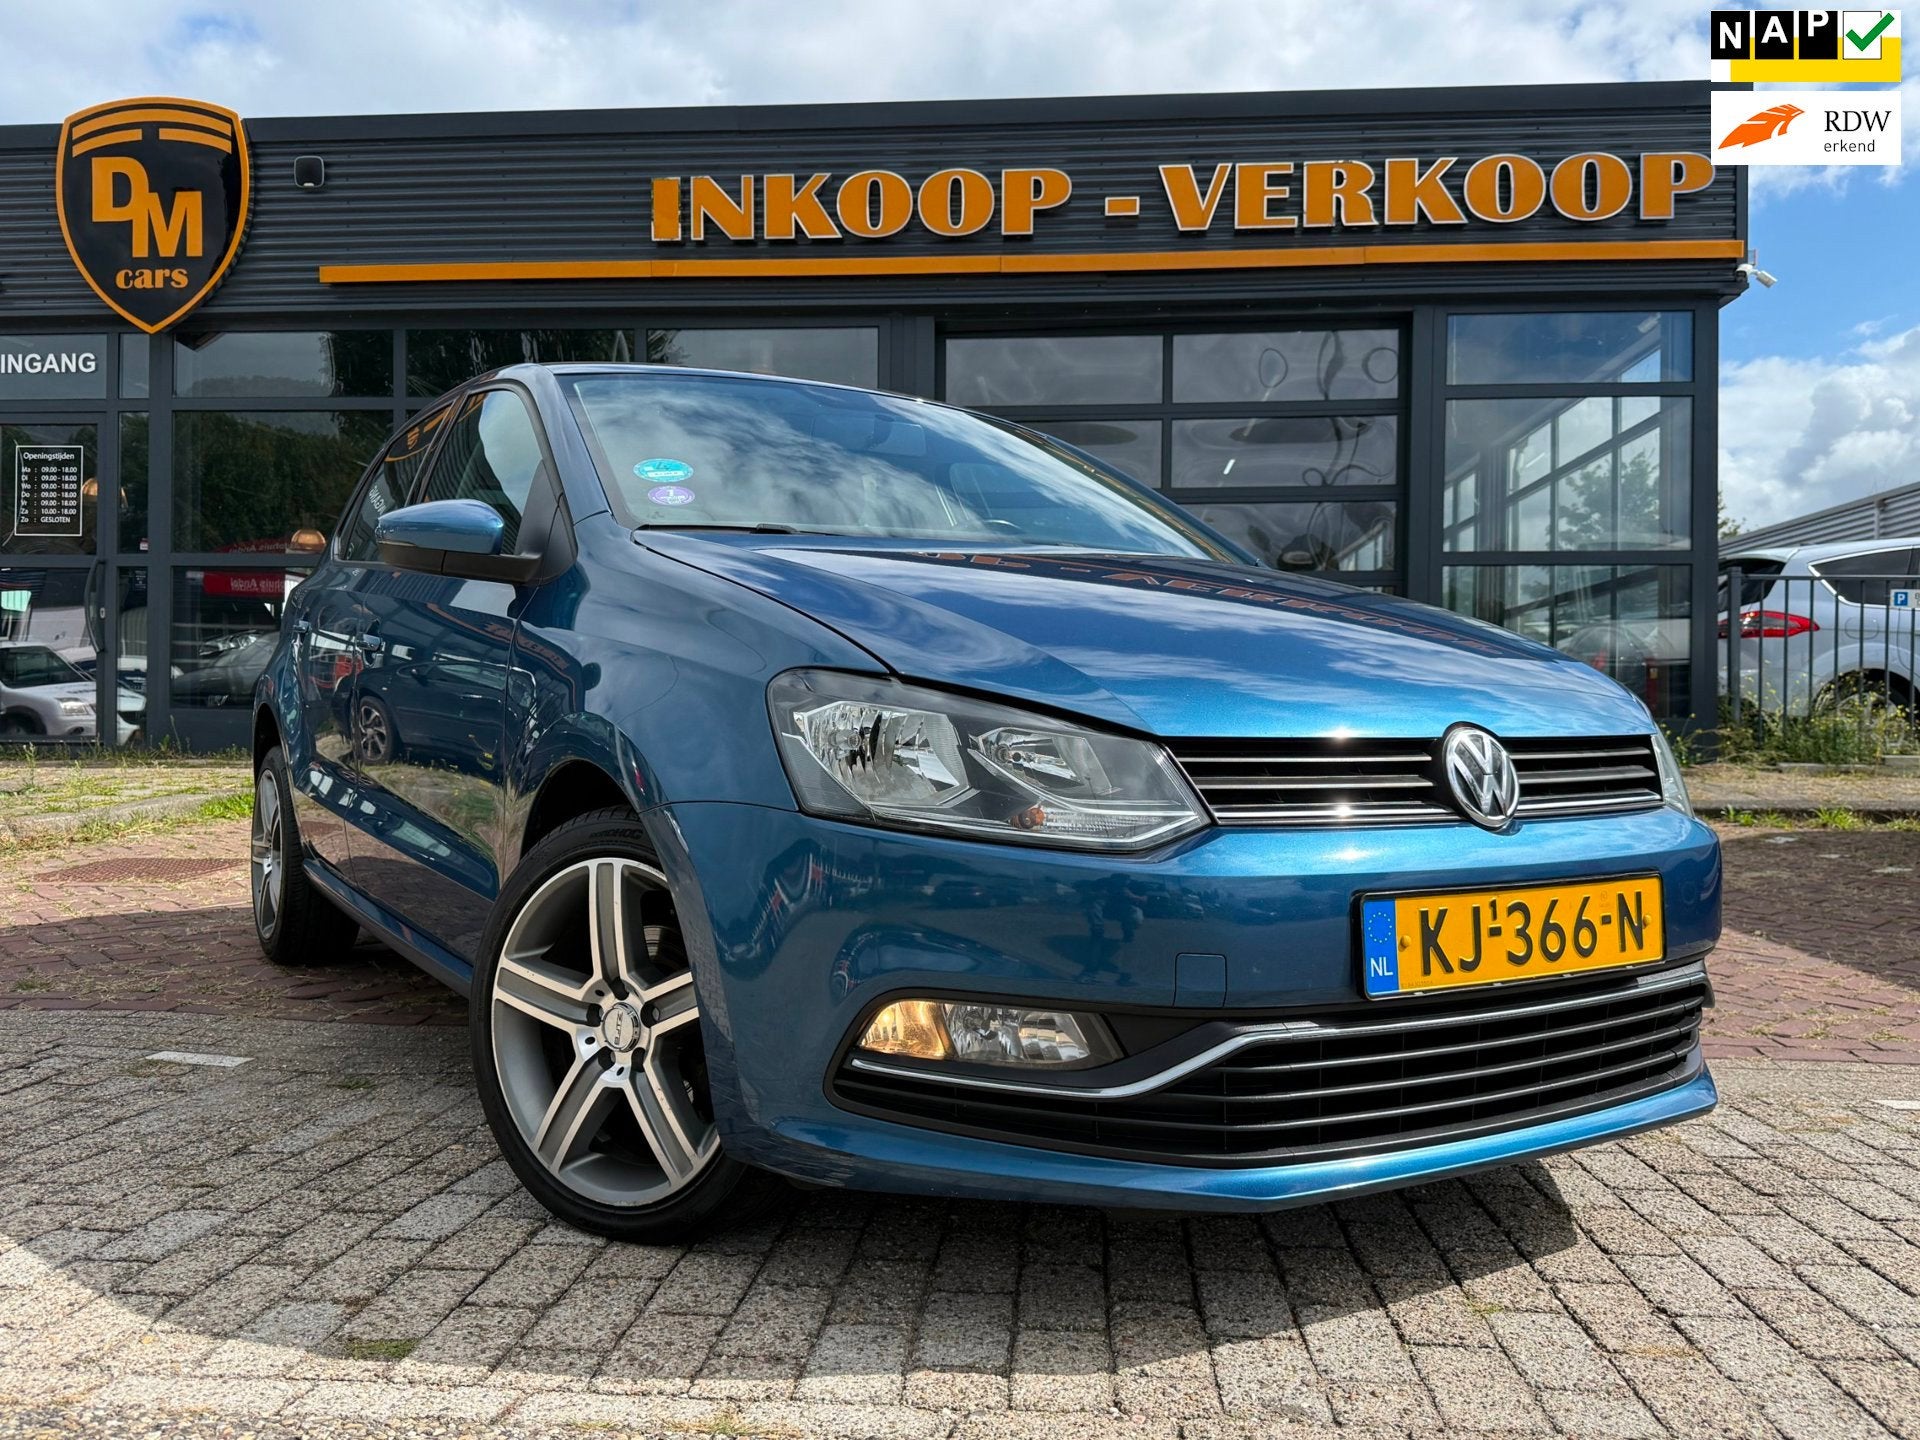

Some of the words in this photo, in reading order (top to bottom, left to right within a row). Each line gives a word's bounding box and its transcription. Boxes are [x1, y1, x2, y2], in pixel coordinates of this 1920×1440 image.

[91, 156, 203, 258] DM
[651, 167, 1072, 242] INKOOP
[1158, 152, 1716, 231] VERKOOP
[115, 266, 189, 290] cars
[23, 452, 75, 461] Openingstijden
[1418, 890, 1644, 977] KJ-366-N
[1370, 957, 1393, 978] NL
